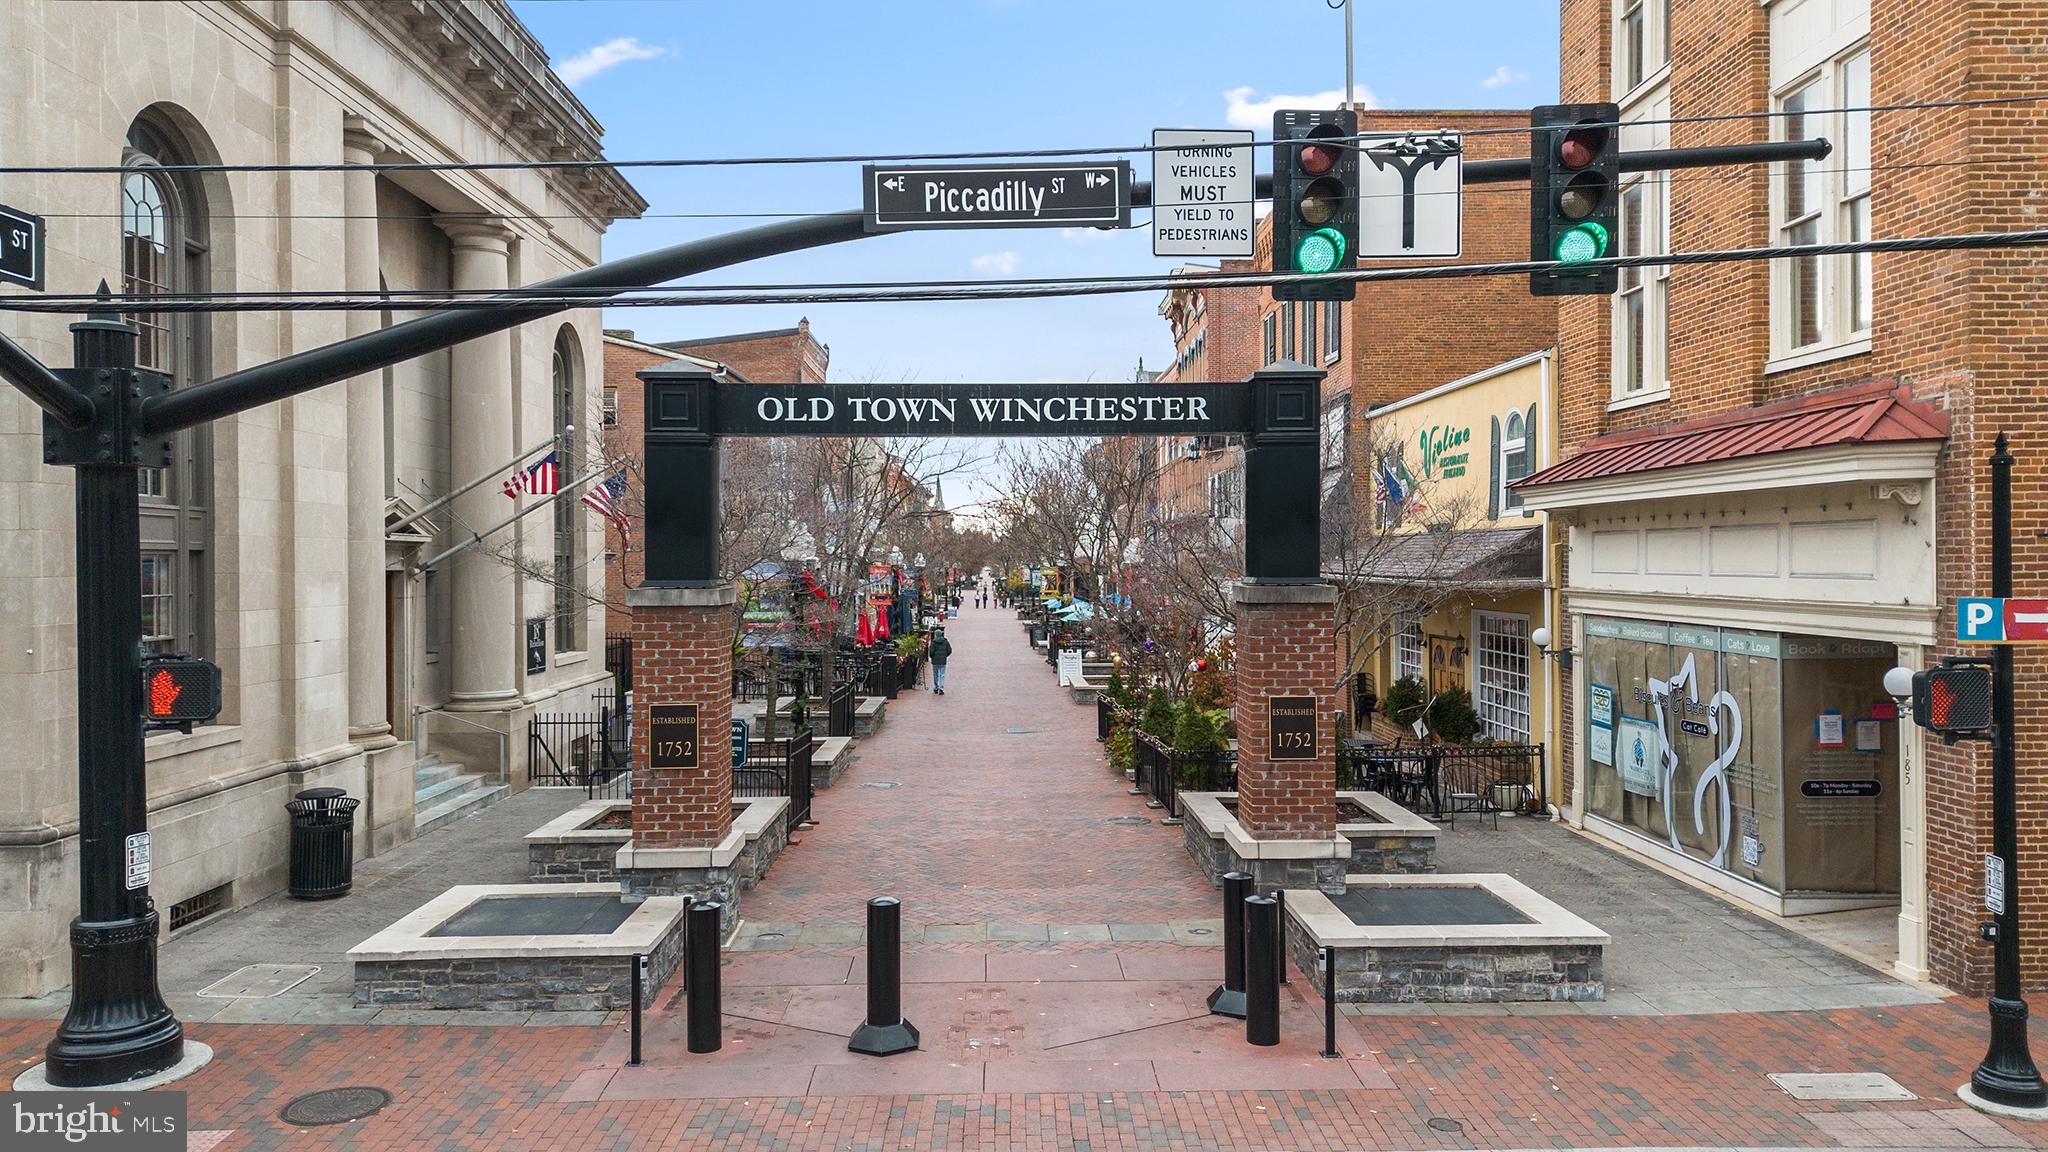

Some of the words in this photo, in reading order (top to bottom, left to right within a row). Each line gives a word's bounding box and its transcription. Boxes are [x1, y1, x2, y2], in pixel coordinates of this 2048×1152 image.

[1171, 165, 1237, 178] VEHICLES
[898, 175, 906, 192] E
[924, 180, 1046, 217] Piccadilly
[1051, 177, 1066, 194] ST
[1085, 172, 1096, 189] W
[1180, 185, 1227, 201] MUST
[1173, 208, 1212, 221] YIELD
[1218, 208, 1234, 221] TO
[12, 229, 29, 250] ST
[1159, 228, 1248, 241] PEDESTRIANS
[756, 396, 835, 422] OLD
[847, 396, 958, 423] TOWN
[969, 396, 1210, 423] WINCHESTER
[1419, 424, 1471, 480] Violino
[1967, 602, 1994, 636] P
[1589, 622, 1618, 635] Sandwiches
[1622, 626, 1640, 638] Baked
[1640, 628, 1664, 640] Goodies
[1674, 632, 1696, 644] Coffee
[1702, 635, 1714, 647] Tea
[1727, 638, 1745, 650] Cats
[1751, 640, 1770, 653] Love
[1788, 643, 1826, 655] Book
[1841, 643, 1886, 656] Adopt
[1272, 708, 1315, 716] ESTABLISHED
[1685, 697, 1717, 718] Beans
[652, 716, 696, 725] ESTABLISHED
[1682, 721, 1693, 731] Cat
[657, 740, 692, 757] 1752
[1277, 732, 1312, 749] 1752
